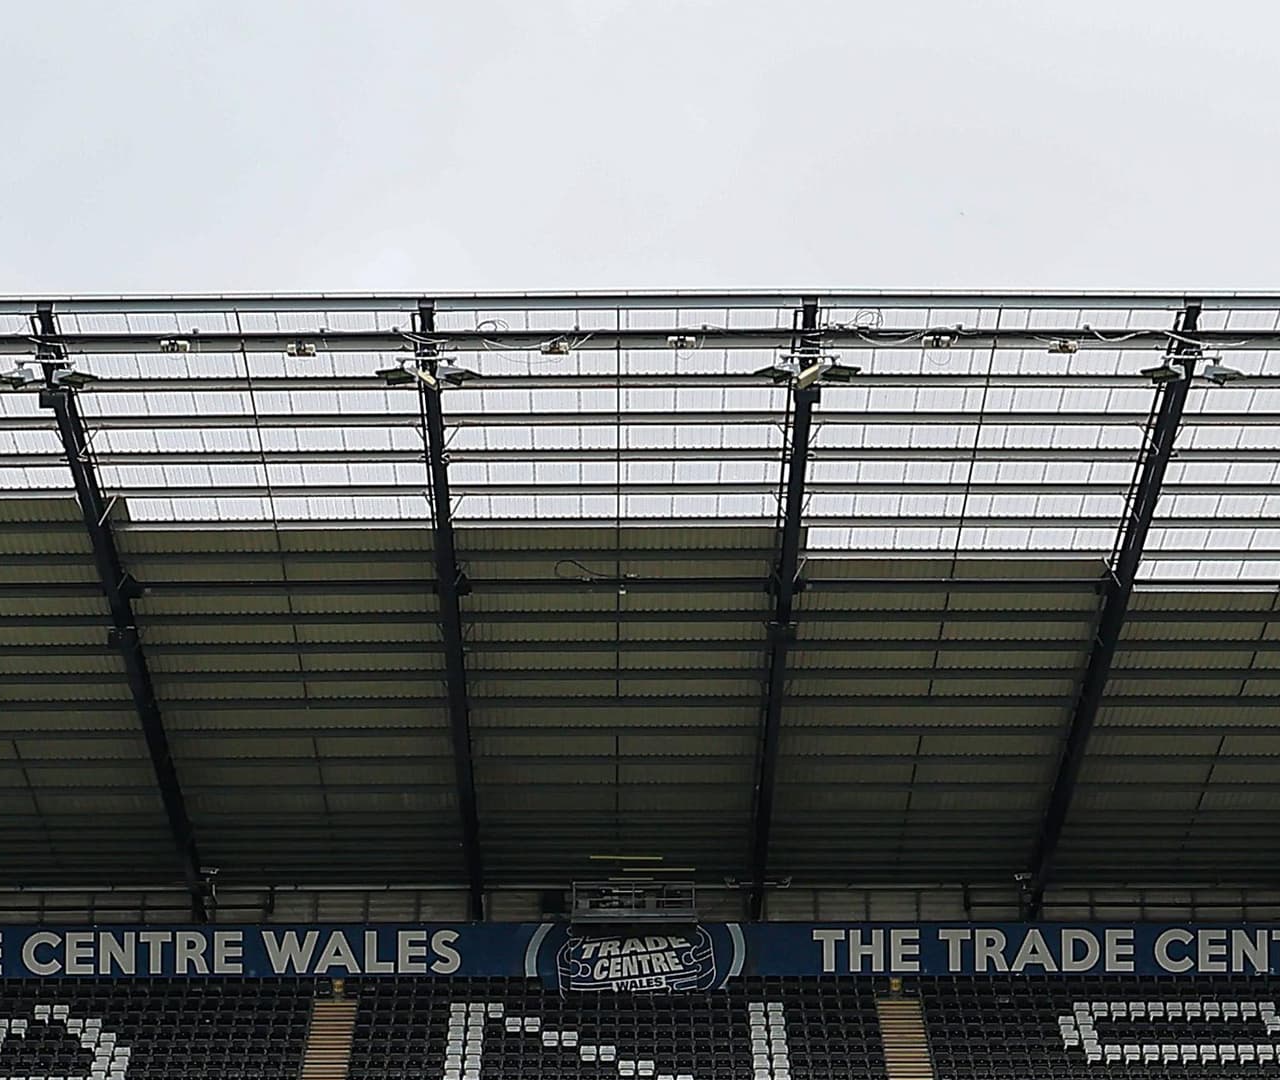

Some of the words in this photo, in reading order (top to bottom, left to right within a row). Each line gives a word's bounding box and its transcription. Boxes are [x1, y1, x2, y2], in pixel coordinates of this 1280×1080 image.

[22, 931, 242, 975] CENTRE
[262, 930, 460, 975] WALES
[582, 936, 692, 960] TRADE
[813, 929, 920, 973] THE
[939, 929, 1134, 973] TRADE
[593, 952, 683, 981] CENTRE
